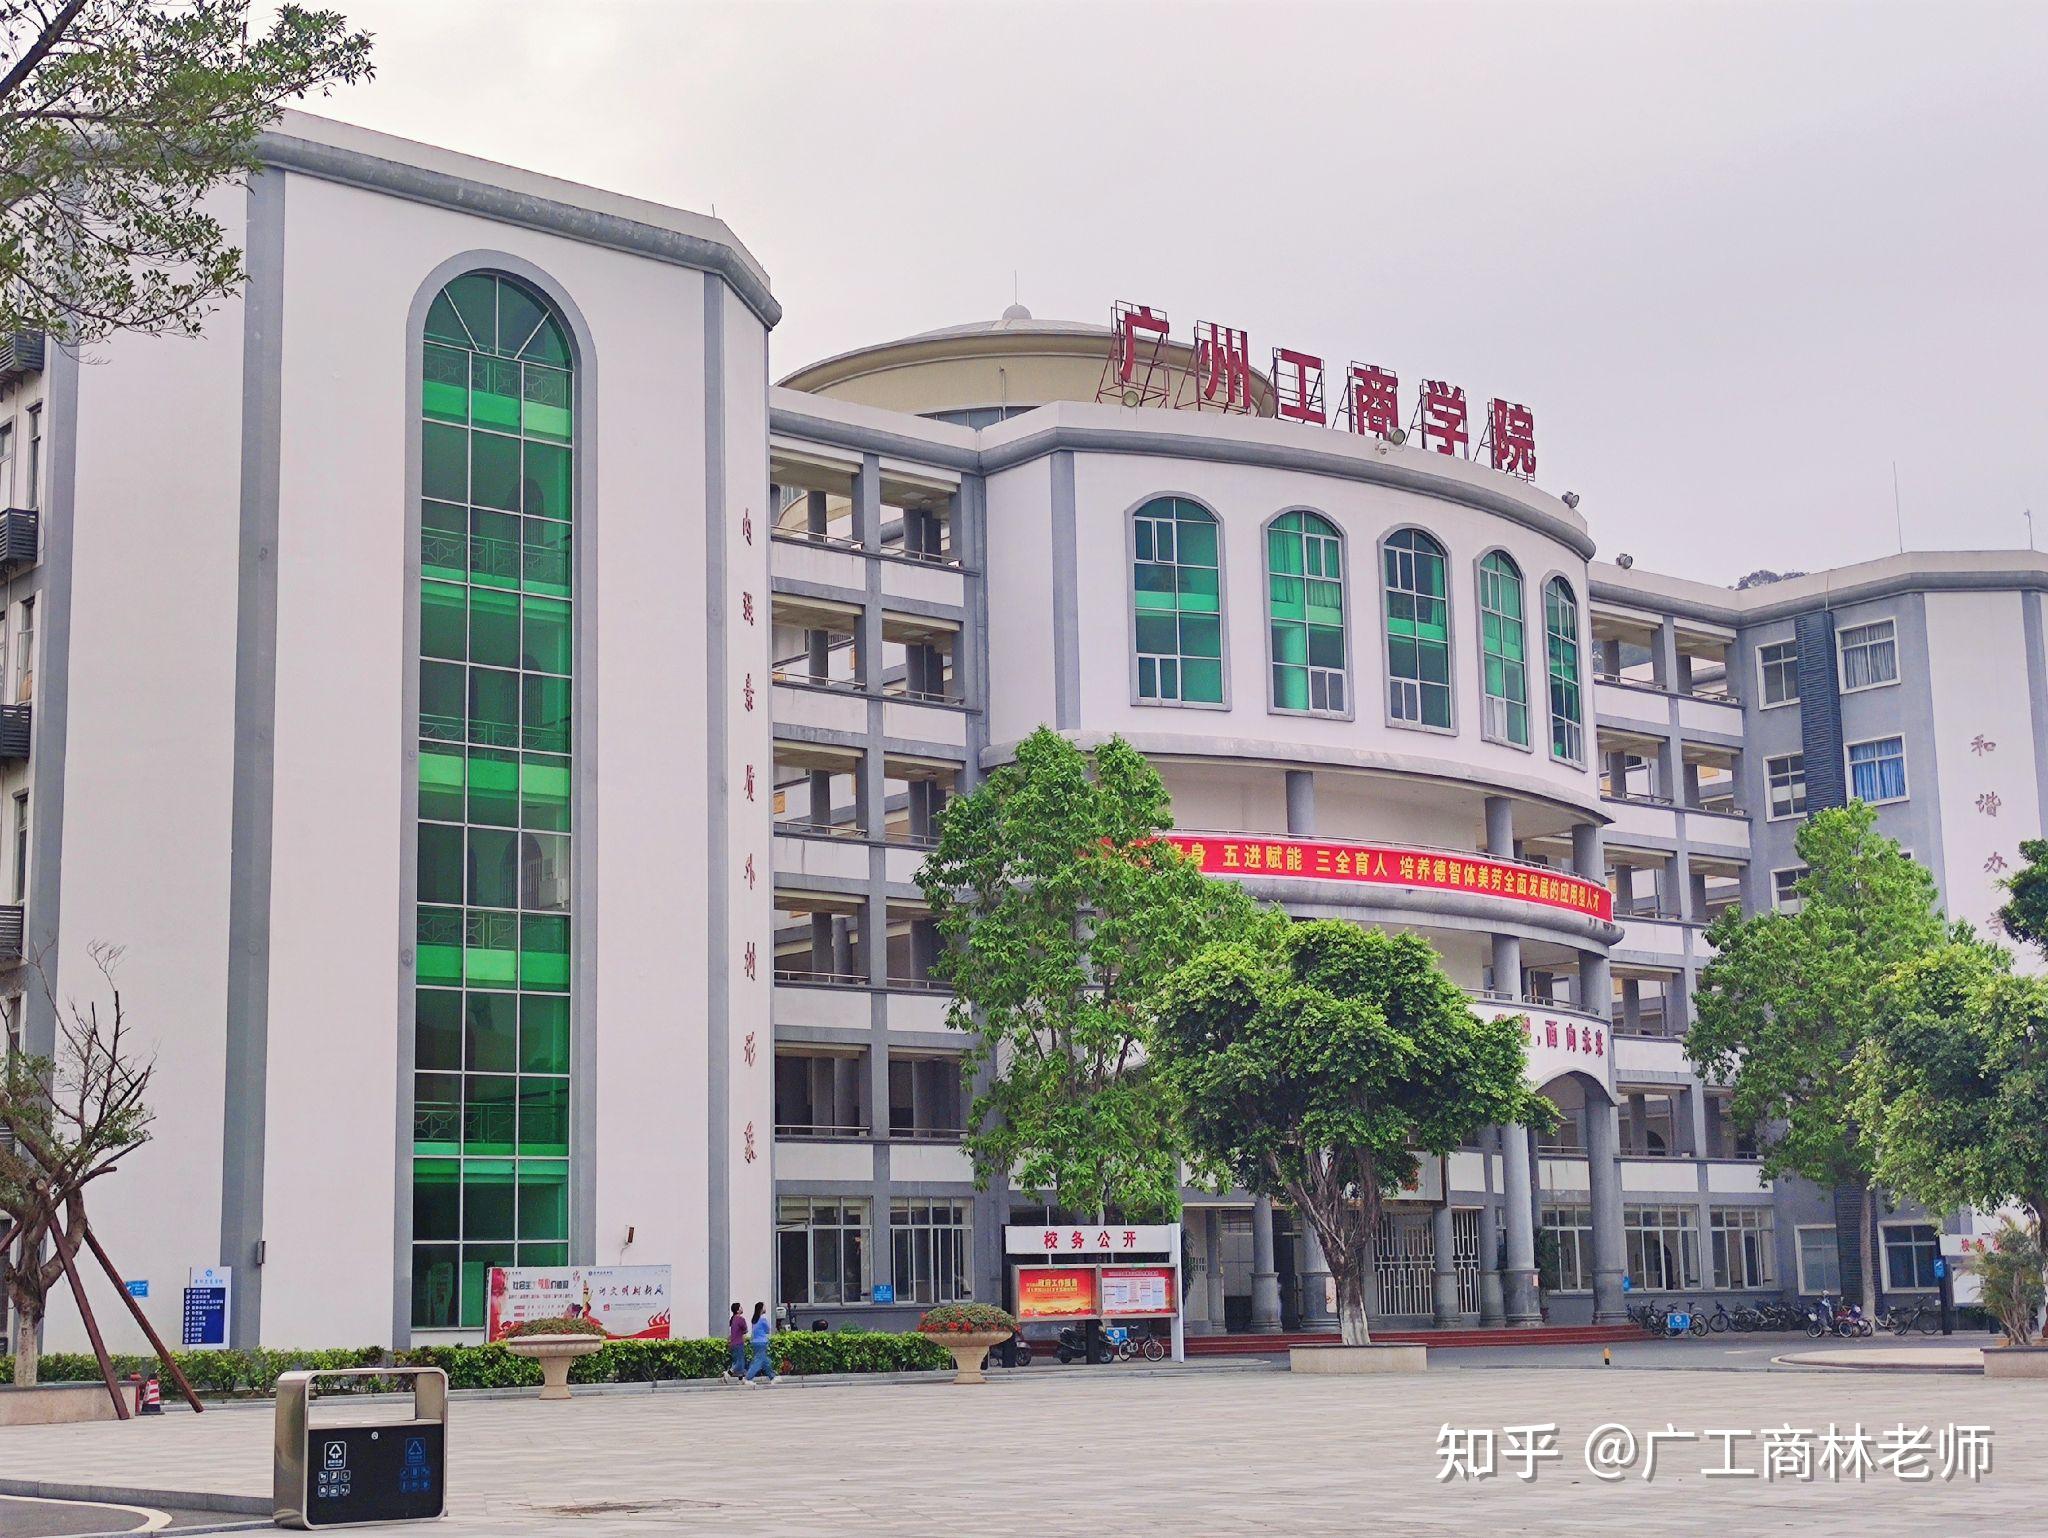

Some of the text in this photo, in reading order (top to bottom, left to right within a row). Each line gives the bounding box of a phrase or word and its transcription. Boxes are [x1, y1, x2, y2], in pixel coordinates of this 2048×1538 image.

[1120, 305, 1537, 474] 广州工商学院
[1223, 844, 1303, 871] 五进赋能
[1316, 850, 1388, 876] 三全育人
[1400, 855, 1600, 912] 培养德智体美劳全面发展的应用型人才
[1043, 1230, 1137, 1249] 校务公开
